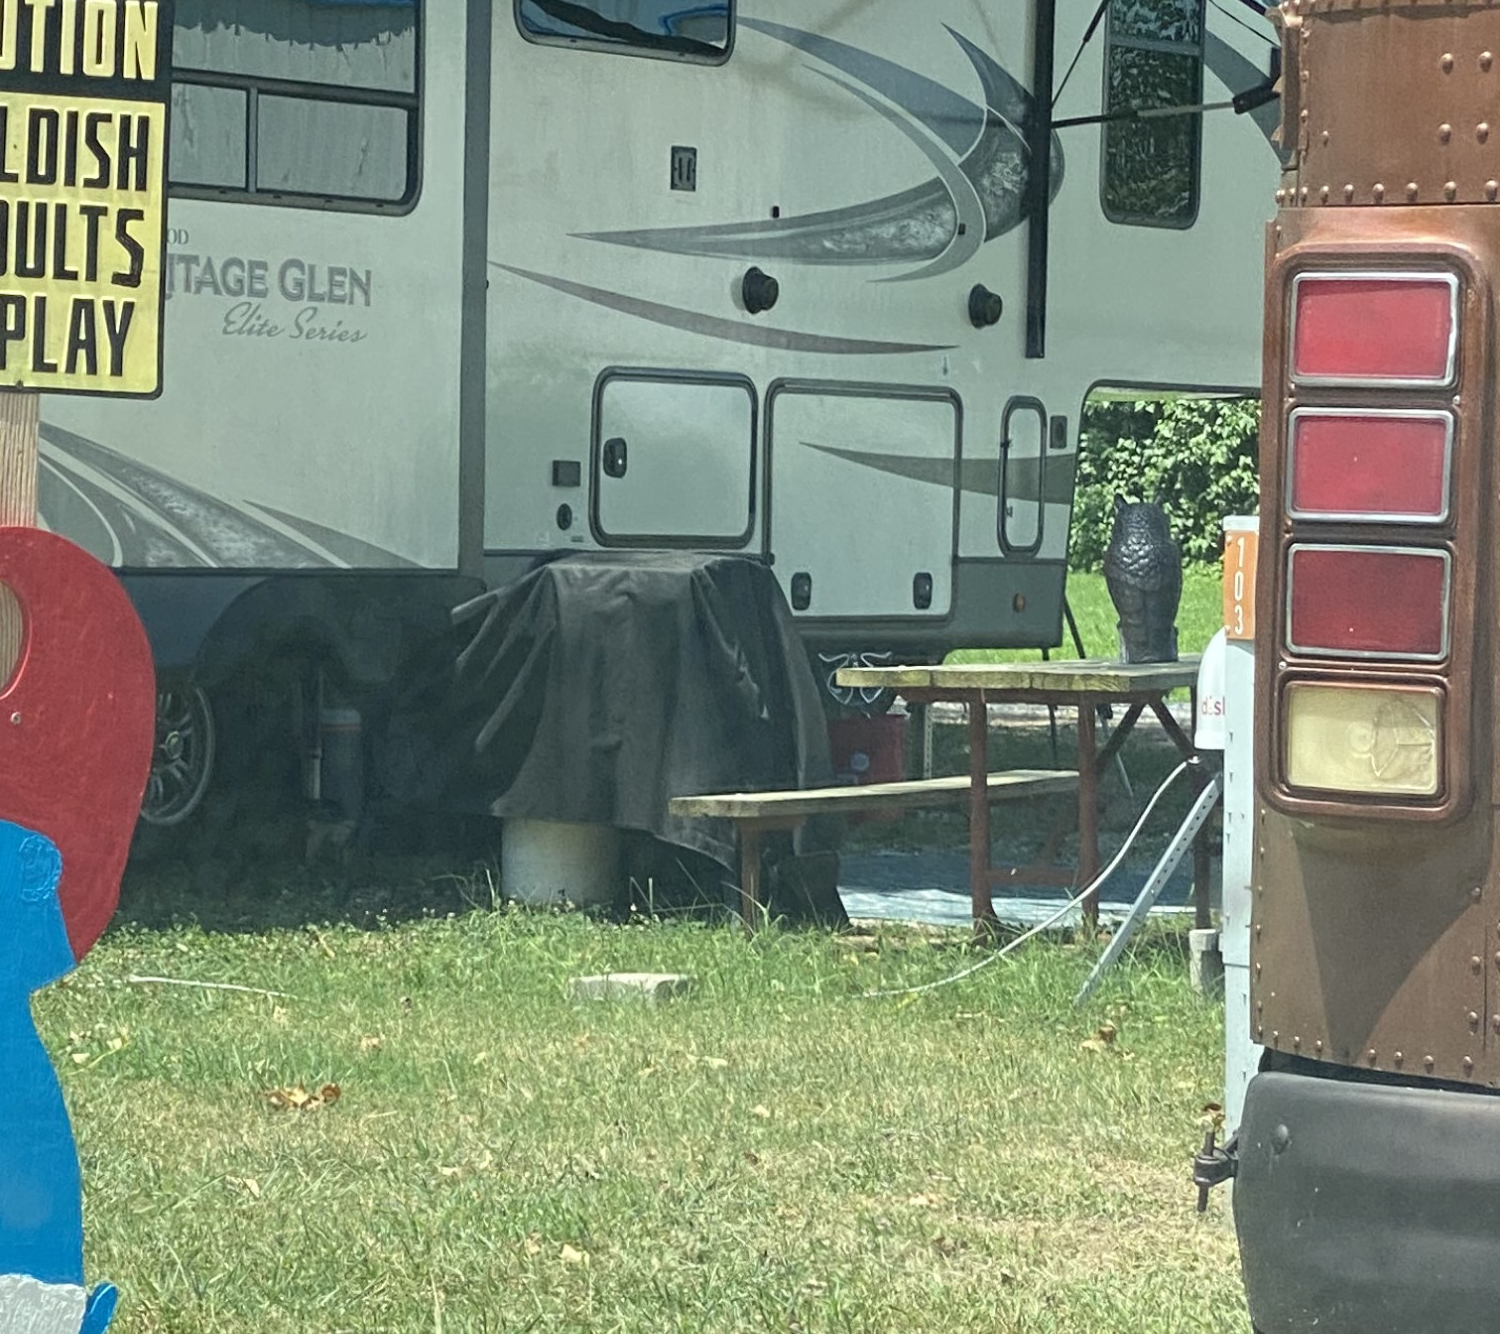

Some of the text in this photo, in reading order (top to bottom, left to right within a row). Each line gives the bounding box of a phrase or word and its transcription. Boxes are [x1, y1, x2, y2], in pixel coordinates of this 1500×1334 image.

[165, 253, 372, 307] ITAGE GLEN
[222, 301, 368, 343] Elite Series
[1233, 536, 1245, 635] 103
